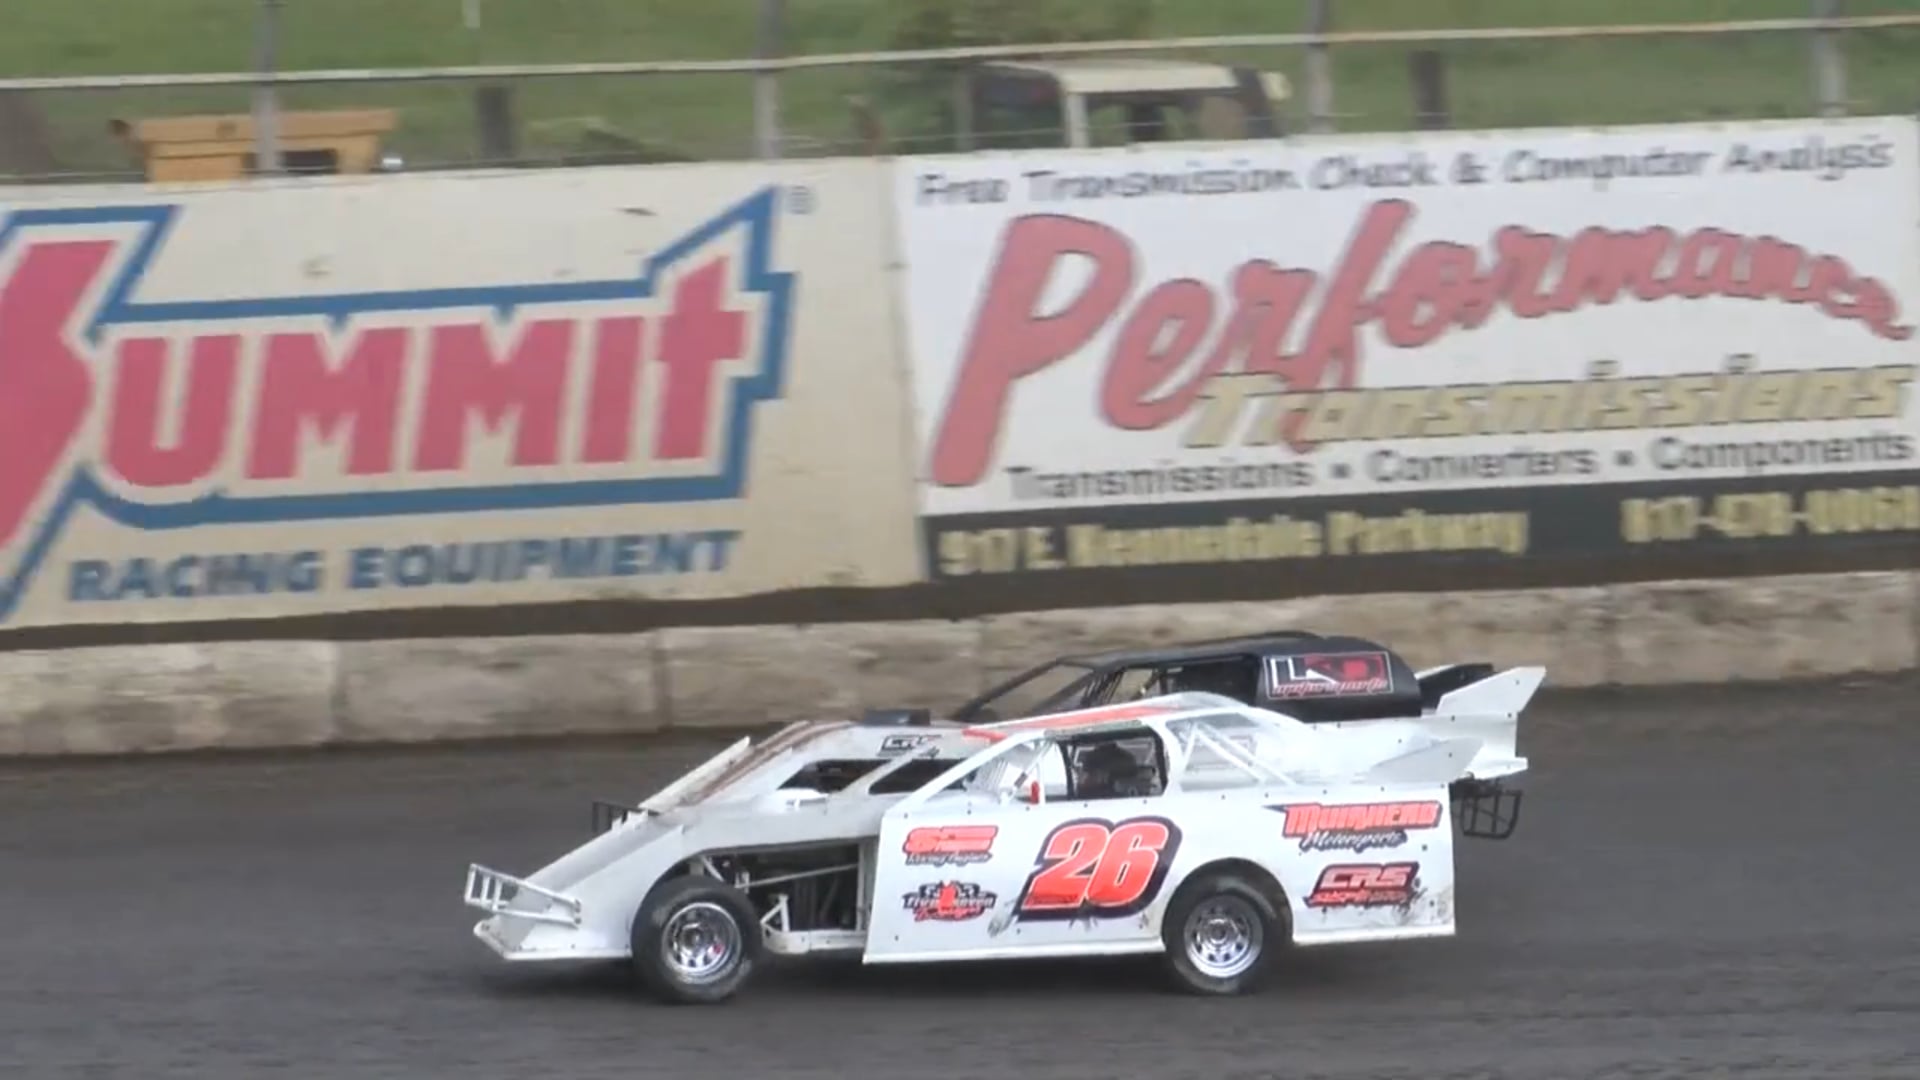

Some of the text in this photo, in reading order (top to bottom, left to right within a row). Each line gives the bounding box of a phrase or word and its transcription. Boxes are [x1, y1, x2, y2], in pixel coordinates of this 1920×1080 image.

[916, 134, 1896, 206] Free Transmission Check & Computer Analysis
[932, 198, 1916, 487] Performance
[1183, 354, 1914, 451] Transmissions
[1003, 434, 1914, 500] Transmissions Converters Components
[68, 530, 743, 602] RACING EQUIPMENT
[1018, 817, 1182, 921] 26
[1318, 864, 1416, 891] CRS
